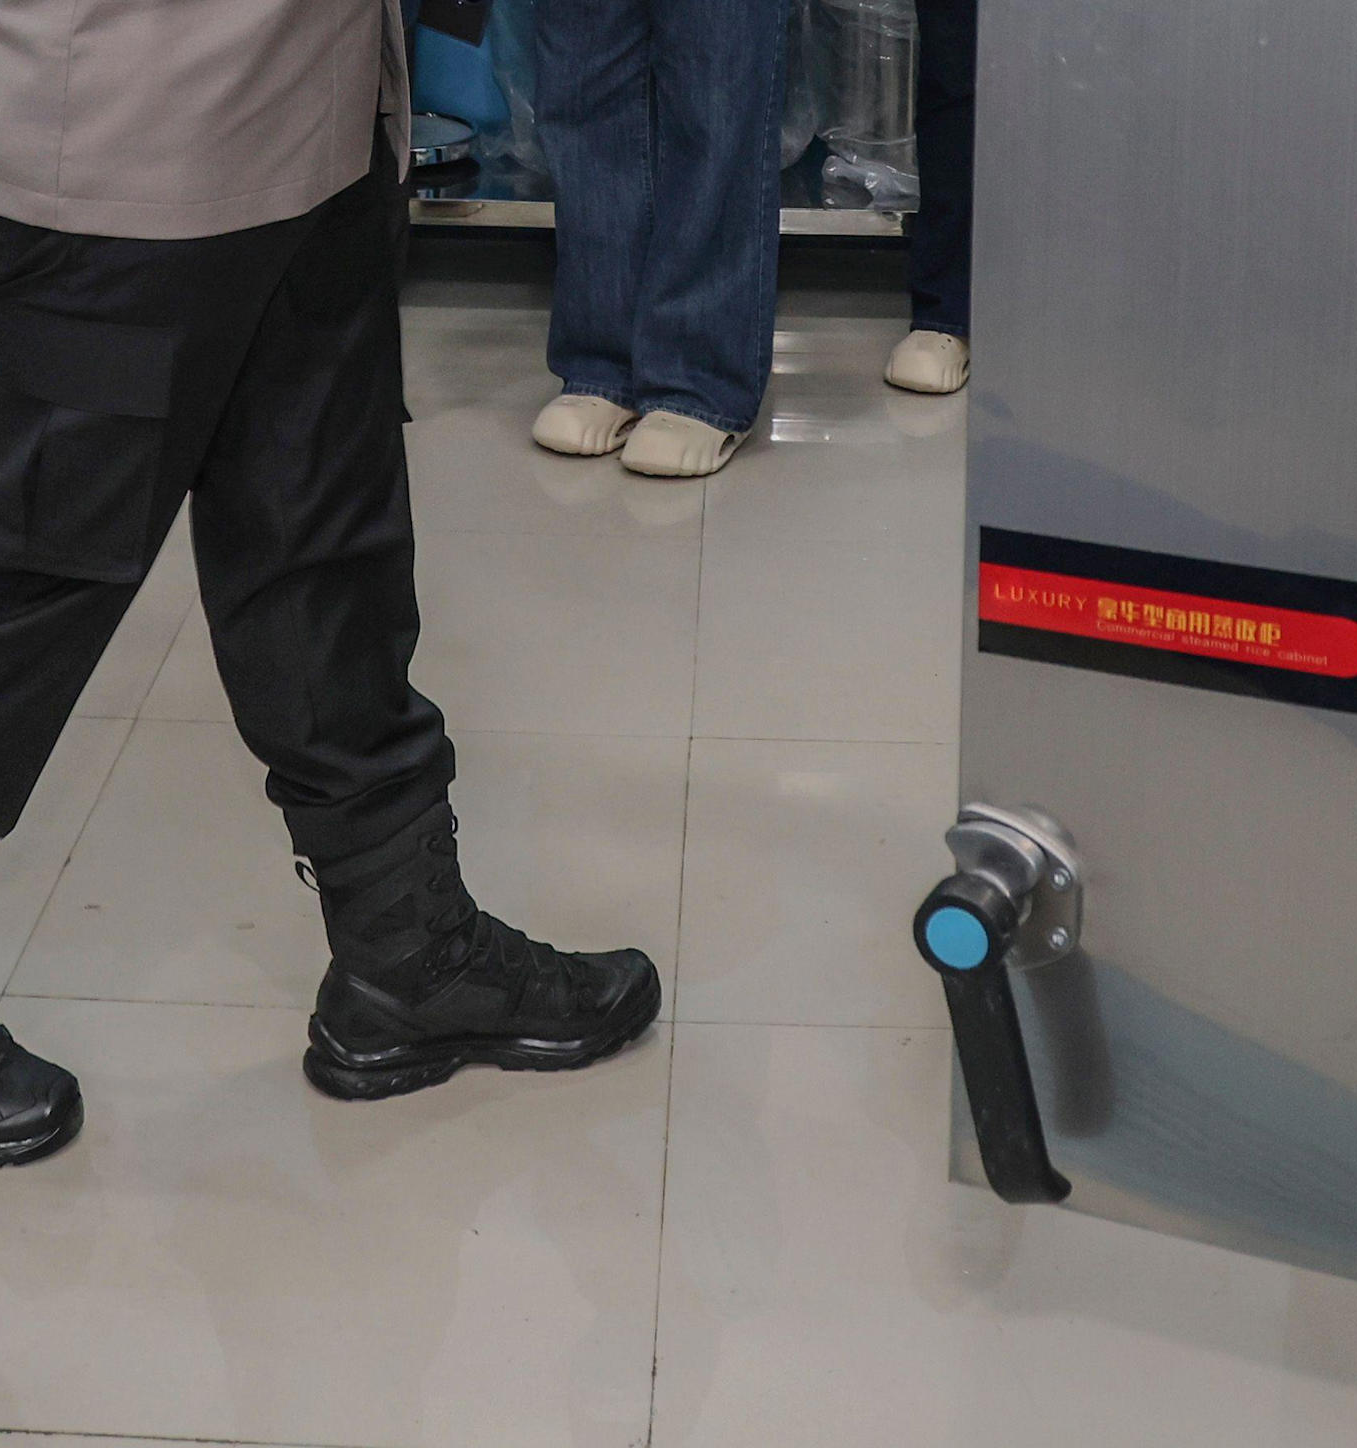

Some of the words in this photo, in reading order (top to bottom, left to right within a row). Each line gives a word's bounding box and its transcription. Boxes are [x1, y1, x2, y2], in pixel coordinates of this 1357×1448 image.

[994, 583, 1088, 611] LUXURY
[1181, 635, 1239, 653] steamed
[1278, 650, 1328, 667] cabinet
